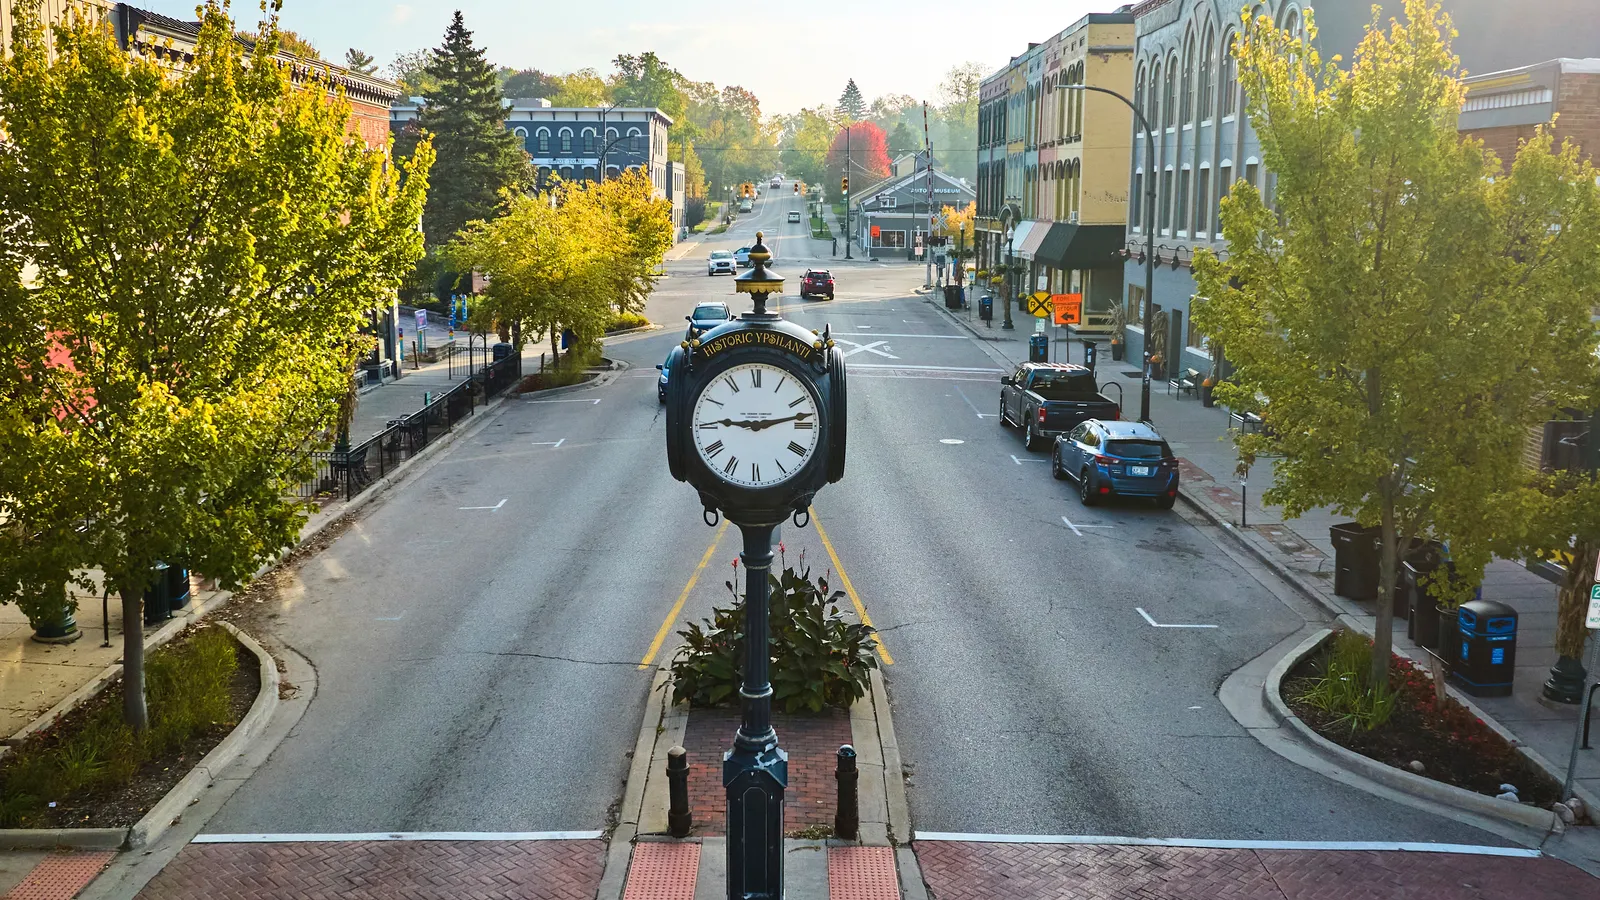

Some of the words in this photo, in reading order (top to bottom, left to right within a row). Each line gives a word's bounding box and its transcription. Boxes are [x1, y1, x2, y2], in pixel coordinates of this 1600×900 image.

[703, 332, 753, 357] HISTORIC
[755, 332, 811, 359] YPSILANTI
[750, 369, 762, 388] XII
